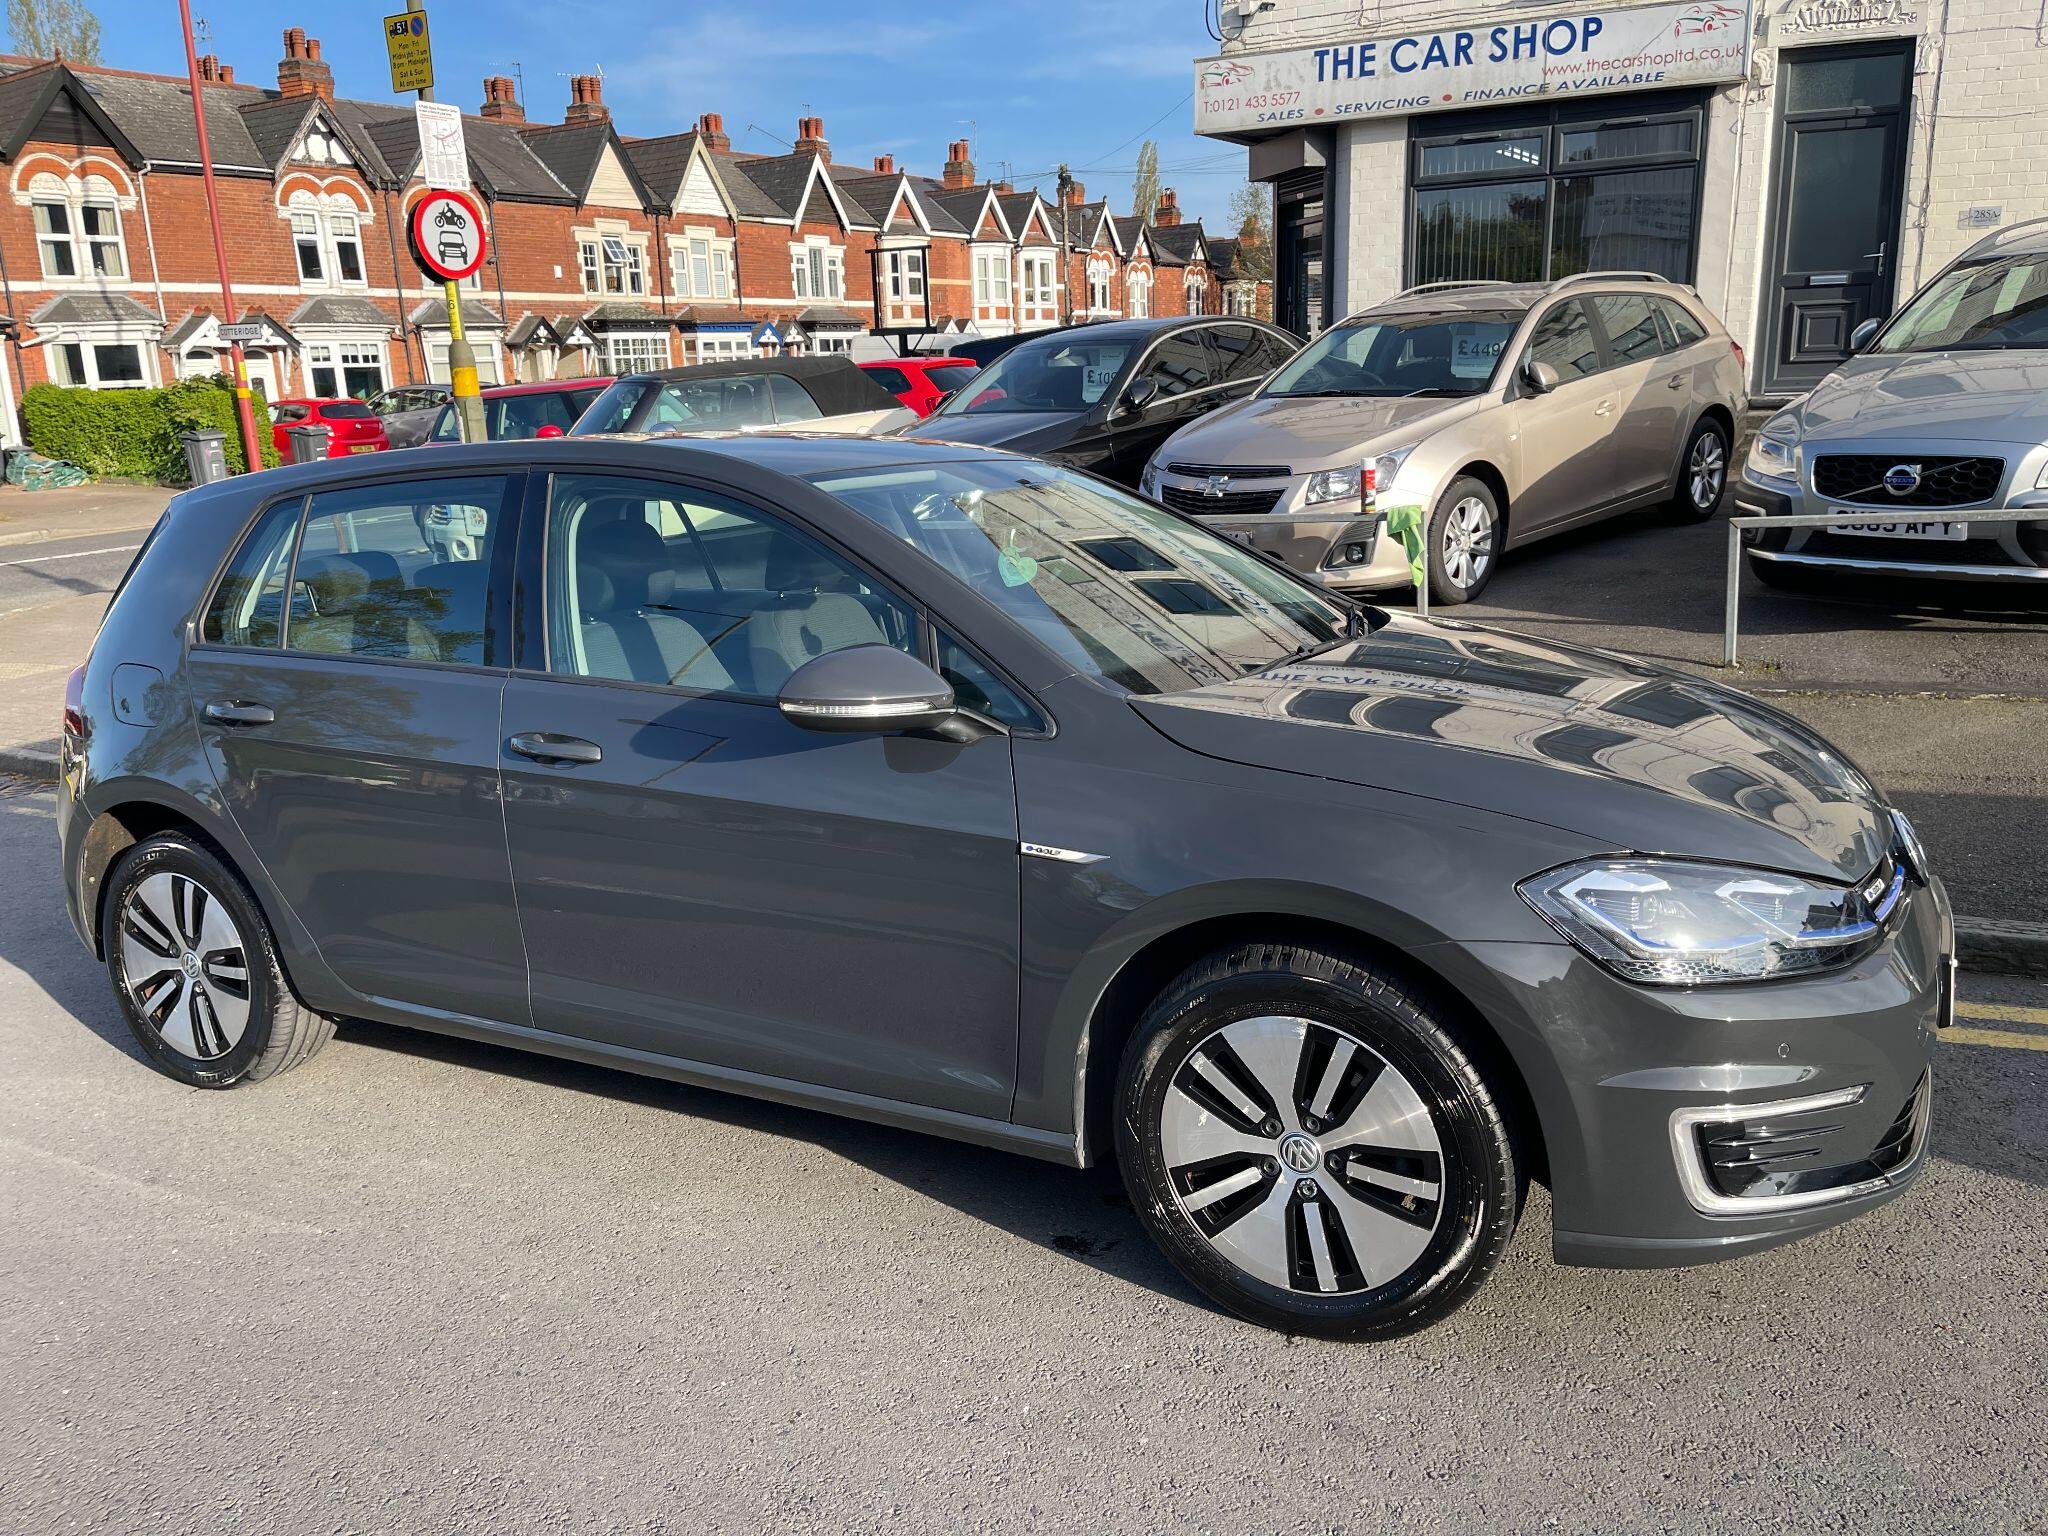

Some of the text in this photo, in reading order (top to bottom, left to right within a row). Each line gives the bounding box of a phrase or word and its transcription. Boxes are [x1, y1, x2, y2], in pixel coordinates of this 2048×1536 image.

[1314, 17, 1603, 82] THE CAR SHOP
[1541, 44, 1744, 77] www.thecarshopltd.co.uk
[1203, 91, 1301, 113] T:0121 433 5577
[1257, 71, 1665, 123] SALES SERVICING FINANCE AVAILABLE
